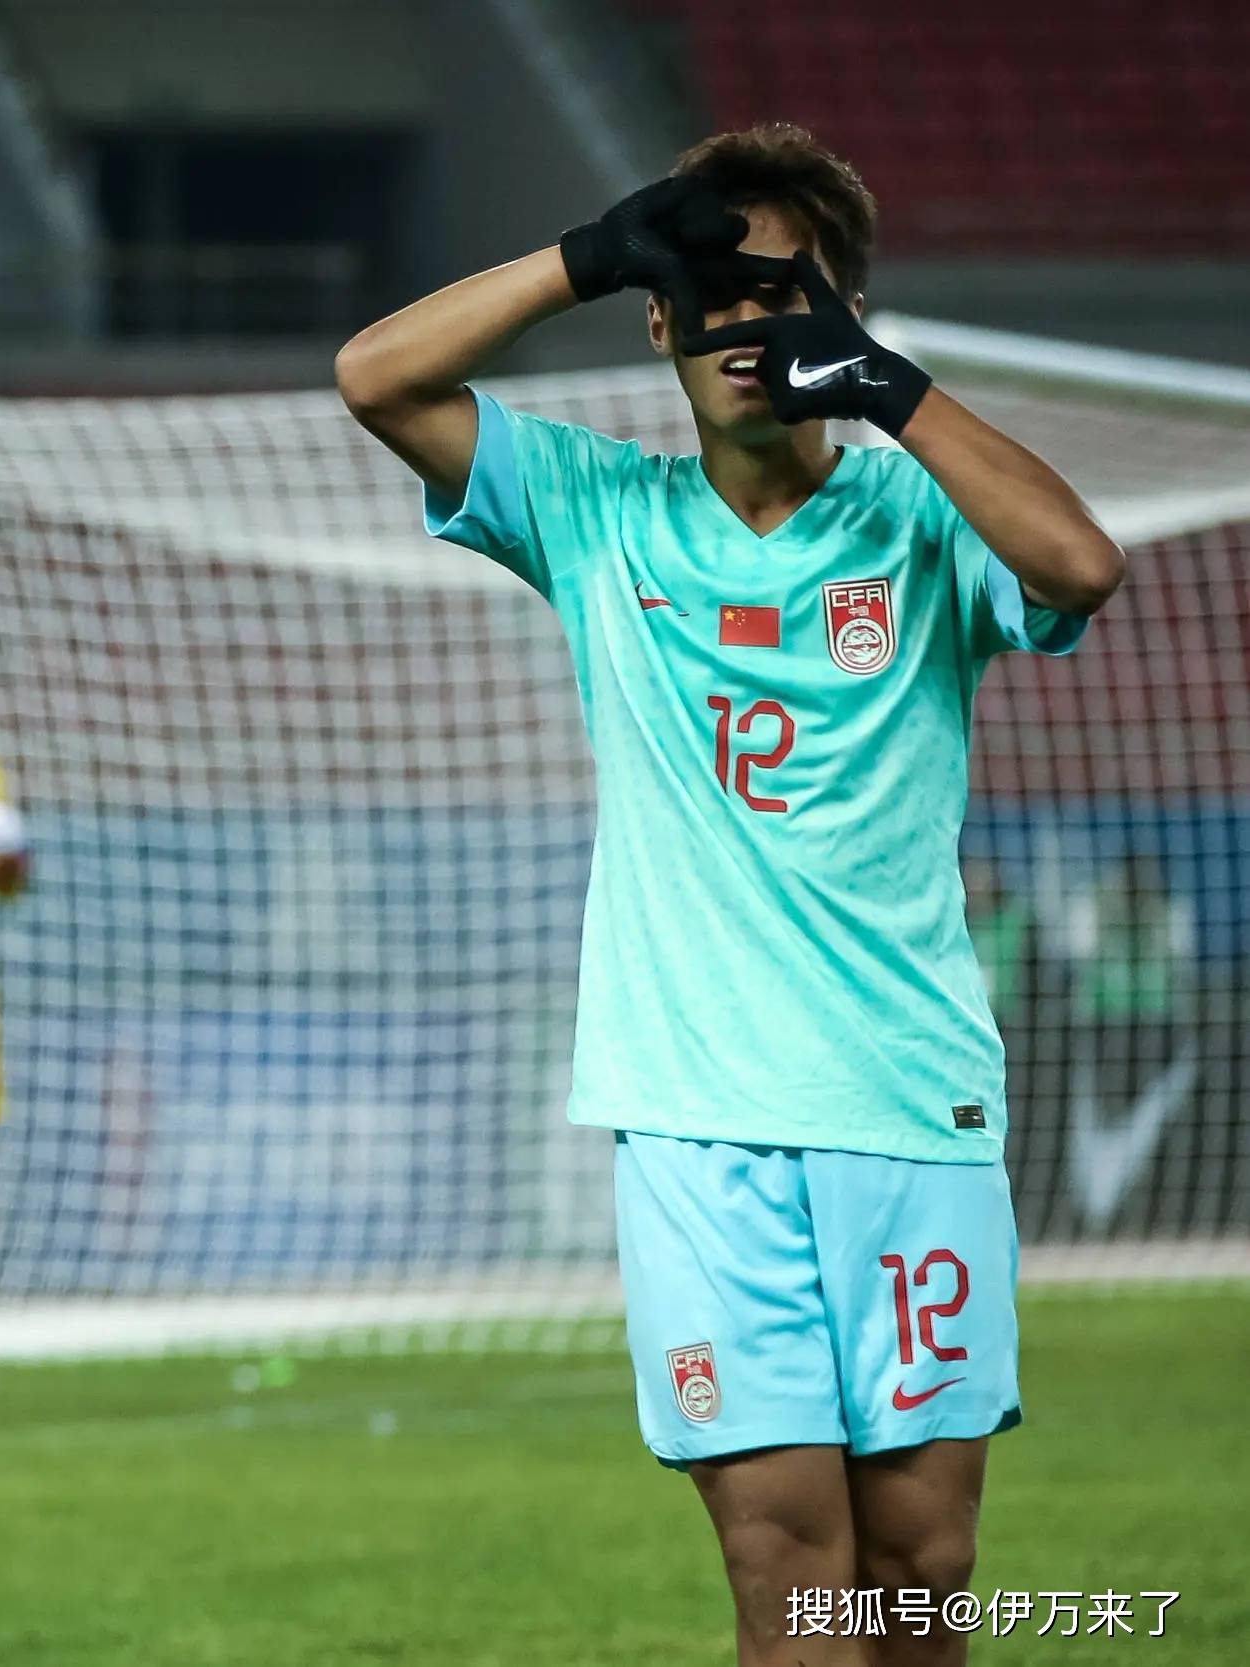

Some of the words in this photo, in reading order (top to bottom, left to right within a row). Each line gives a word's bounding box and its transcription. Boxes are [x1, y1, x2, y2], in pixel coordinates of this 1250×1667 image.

[831, 587, 883, 608] CFA
[706, 695, 796, 813] 12
[879, 1249, 969, 1364] 12
